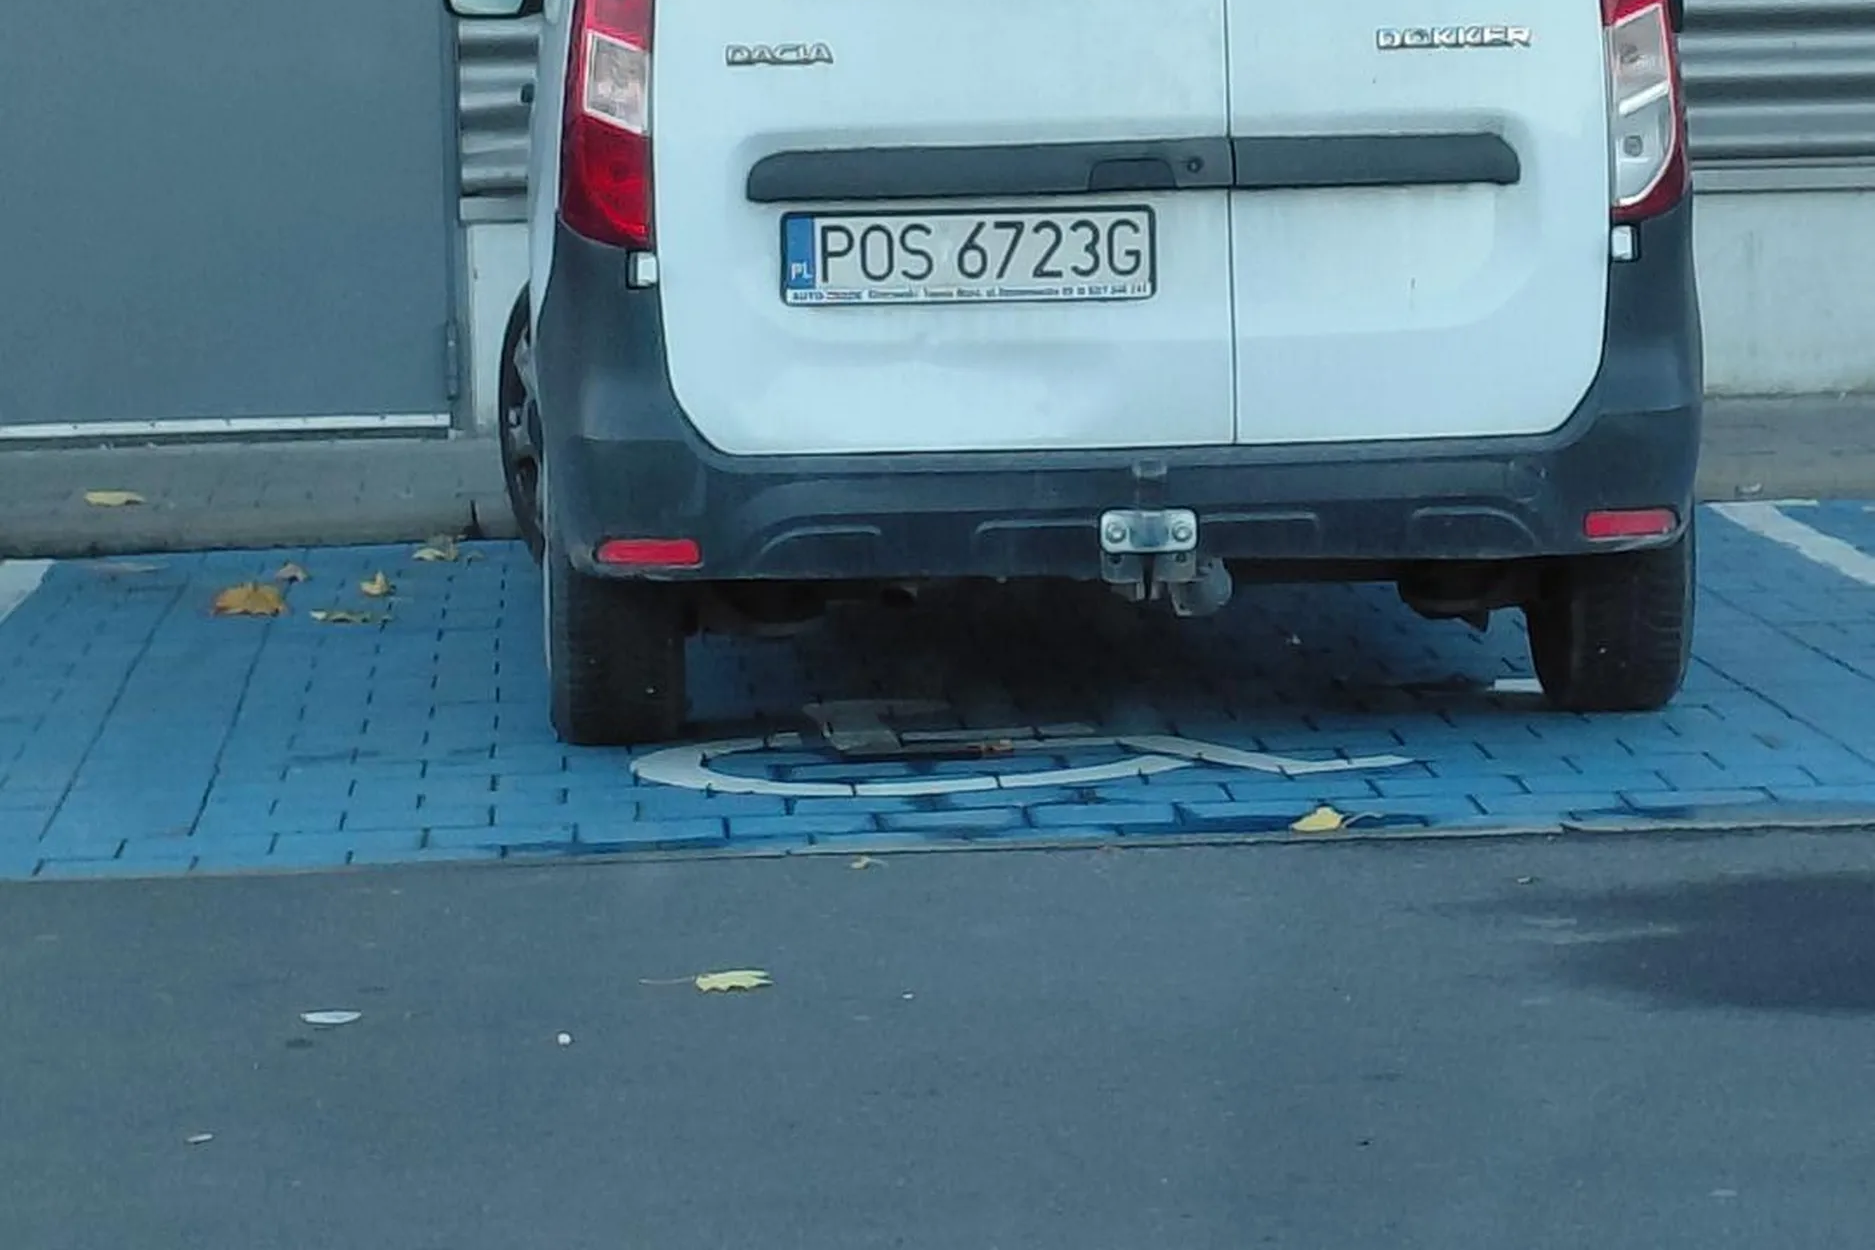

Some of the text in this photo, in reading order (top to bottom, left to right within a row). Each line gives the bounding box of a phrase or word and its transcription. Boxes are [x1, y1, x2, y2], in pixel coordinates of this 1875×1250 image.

[1377, 26, 1531, 50] DOKKER
[726, 42, 834, 67] DACIA
[820, 219, 1143, 283] POS 6723G
[791, 262, 812, 280] PL
